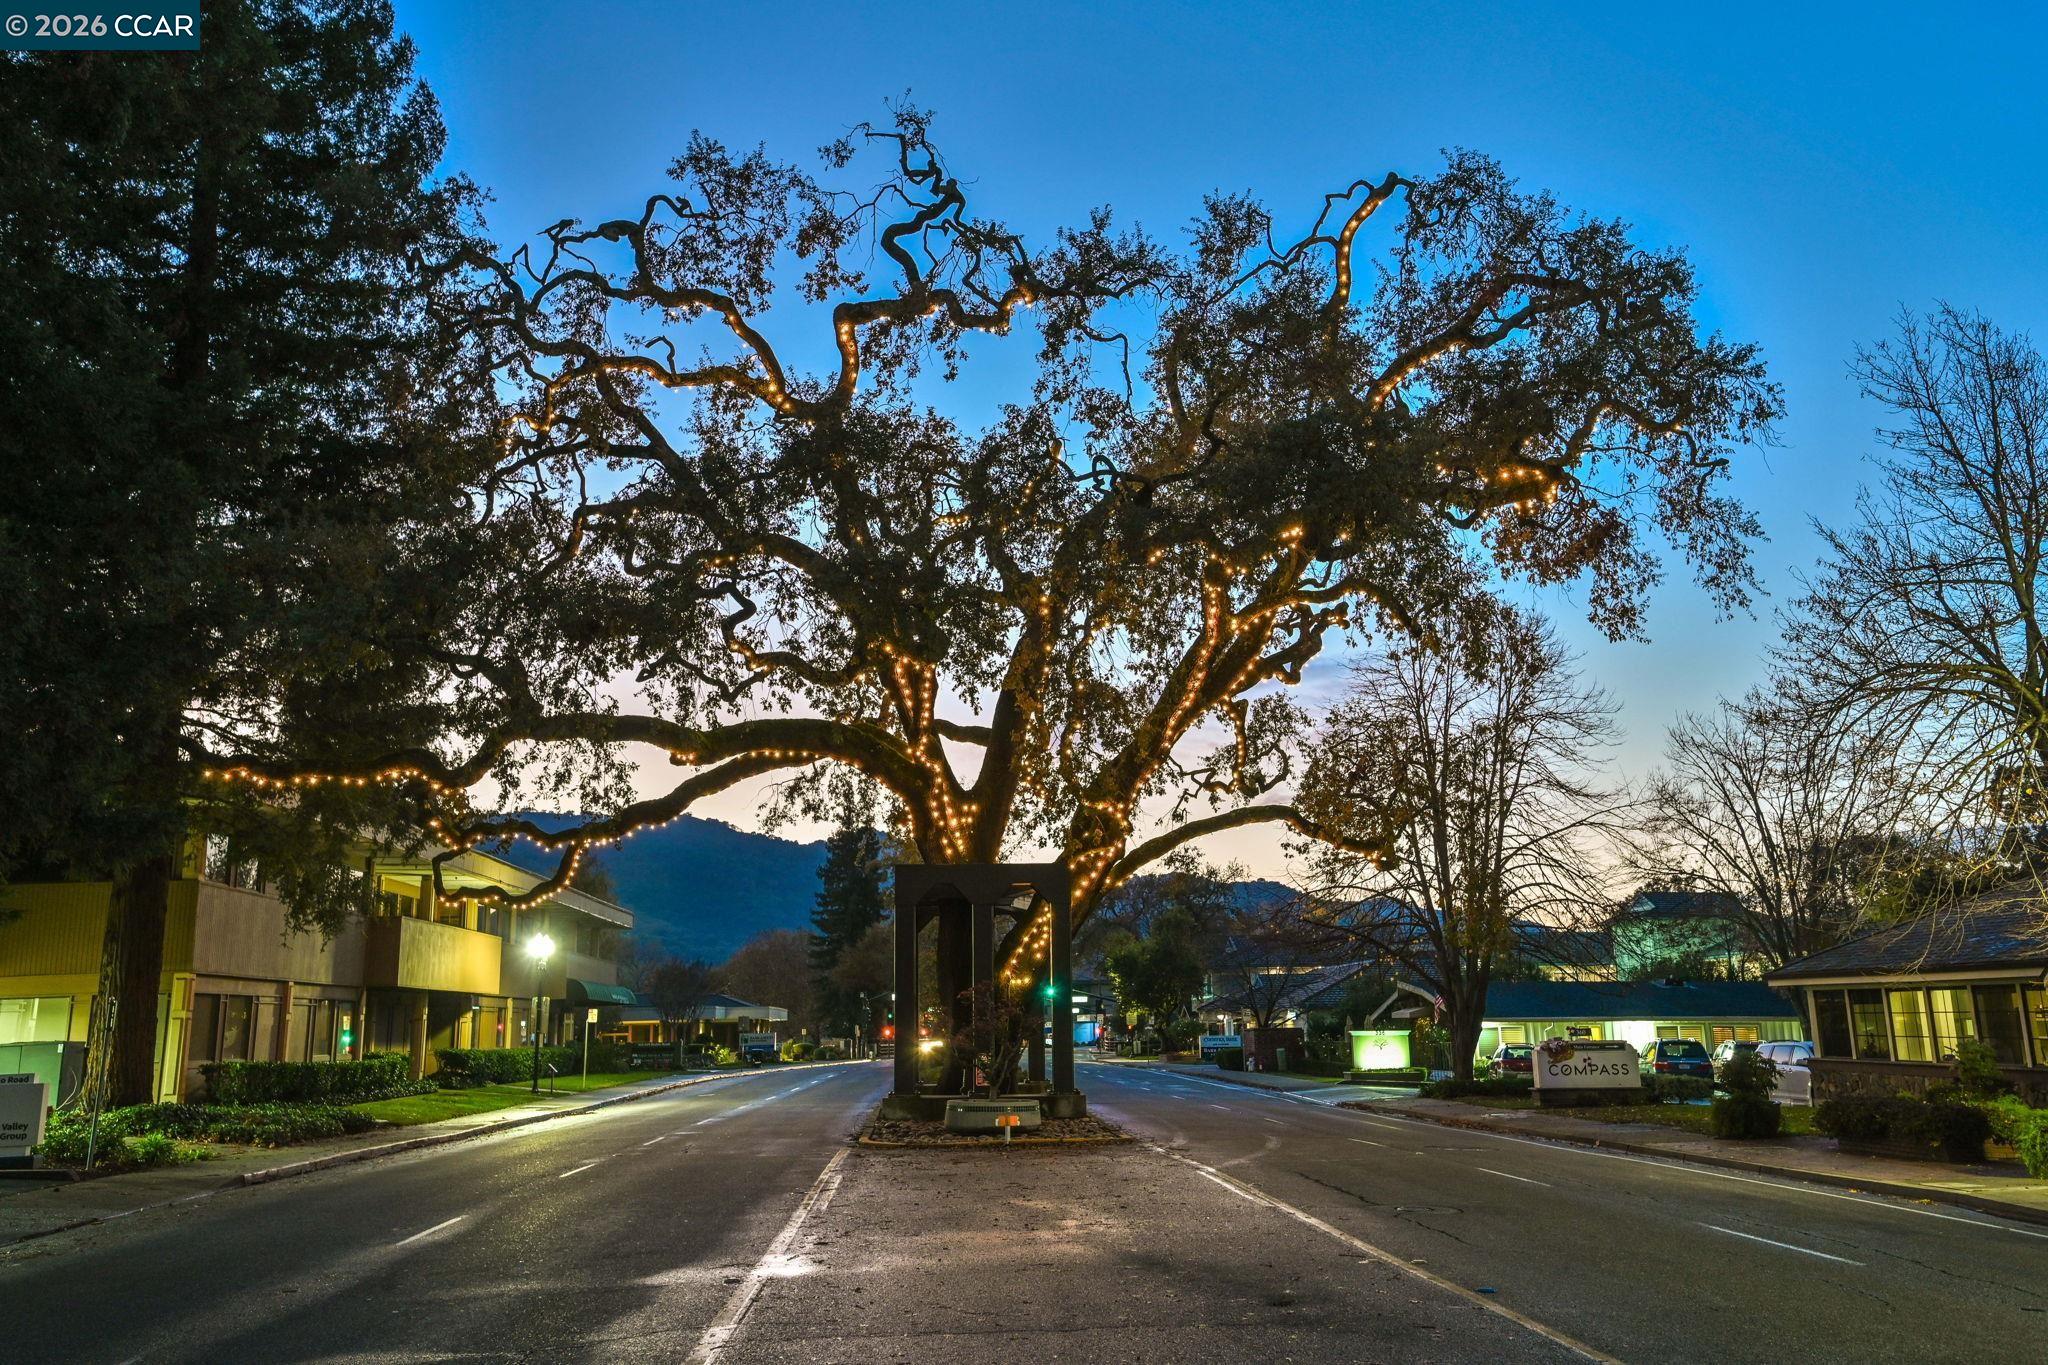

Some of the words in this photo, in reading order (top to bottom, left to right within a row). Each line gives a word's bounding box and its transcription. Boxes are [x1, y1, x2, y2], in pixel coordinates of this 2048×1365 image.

[1548, 1063, 1630, 1076] COMPASS
[7, 1076, 29, 1084] Road
[2, 1122, 29, 1131] Valley
[0, 1133, 28, 1141] Group
